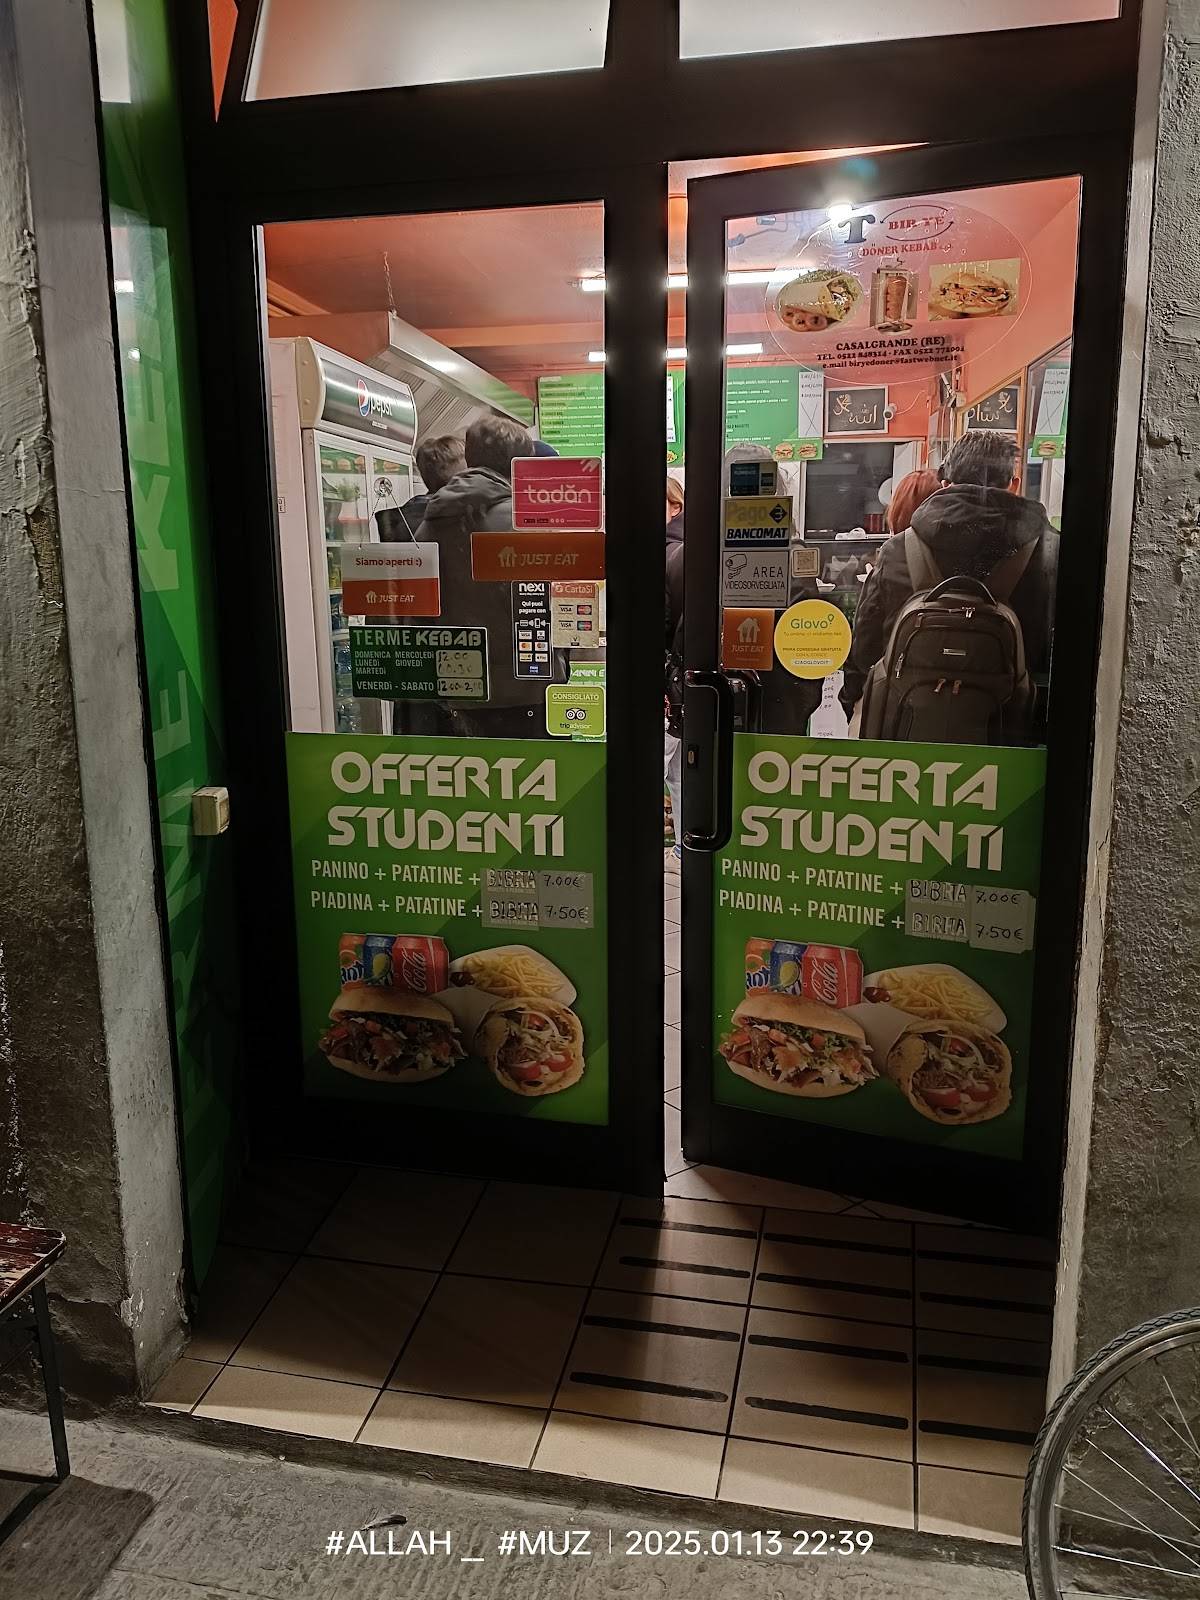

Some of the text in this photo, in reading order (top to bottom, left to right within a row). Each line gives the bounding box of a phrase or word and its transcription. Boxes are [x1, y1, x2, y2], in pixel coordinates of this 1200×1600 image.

[862, 243, 899, 256] DÖNER
[901, 241, 938, 253] KEBAB
[836, 336, 946, 351] CASALGRANDE (RE)
[727, 528, 788, 539] BANCOMAT
[355, 557, 383, 566] Siamo
[385, 557, 413, 567] aperti
[519, 553, 579, 567] JUST EAT
[753, 566, 784, 578] AREA
[518, 582, 545, 592] nexi
[725, 580, 786, 590] VIDEOSORVEGLIATA
[379, 594, 415, 603] JUST EAT
[790, 618, 828, 629] Glovo
[353, 629, 482, 647] TERME KEBAB
[354, 650, 391, 659] DOMENICA
[731, 645, 765, 653] JUST EAT
[401, 681, 434, 691] SABATO
[552, 692, 600, 701] CONSIGLIATO
[559, 722, 593, 731] tripadvisor
[330, 751, 556, 801] OFFERTA
[748, 750, 999, 811] OFFERTA
[327, 806, 565, 857] STUDENTI
[740, 805, 1004, 872] STUDENTI
[311, 859, 481, 886] PANINO + PATATINE +
[721, 858, 903, 895] PANINO + PATATINE +
[311, 890, 483, 919] PIADINA + PATATINE +
[975, 890, 1021, 905] 7.00€
[544, 905, 586, 920] 7.50€
[719, 889, 905, 929] PIADINA + PATATINE +
[975, 923, 1024, 940] 7.50€
